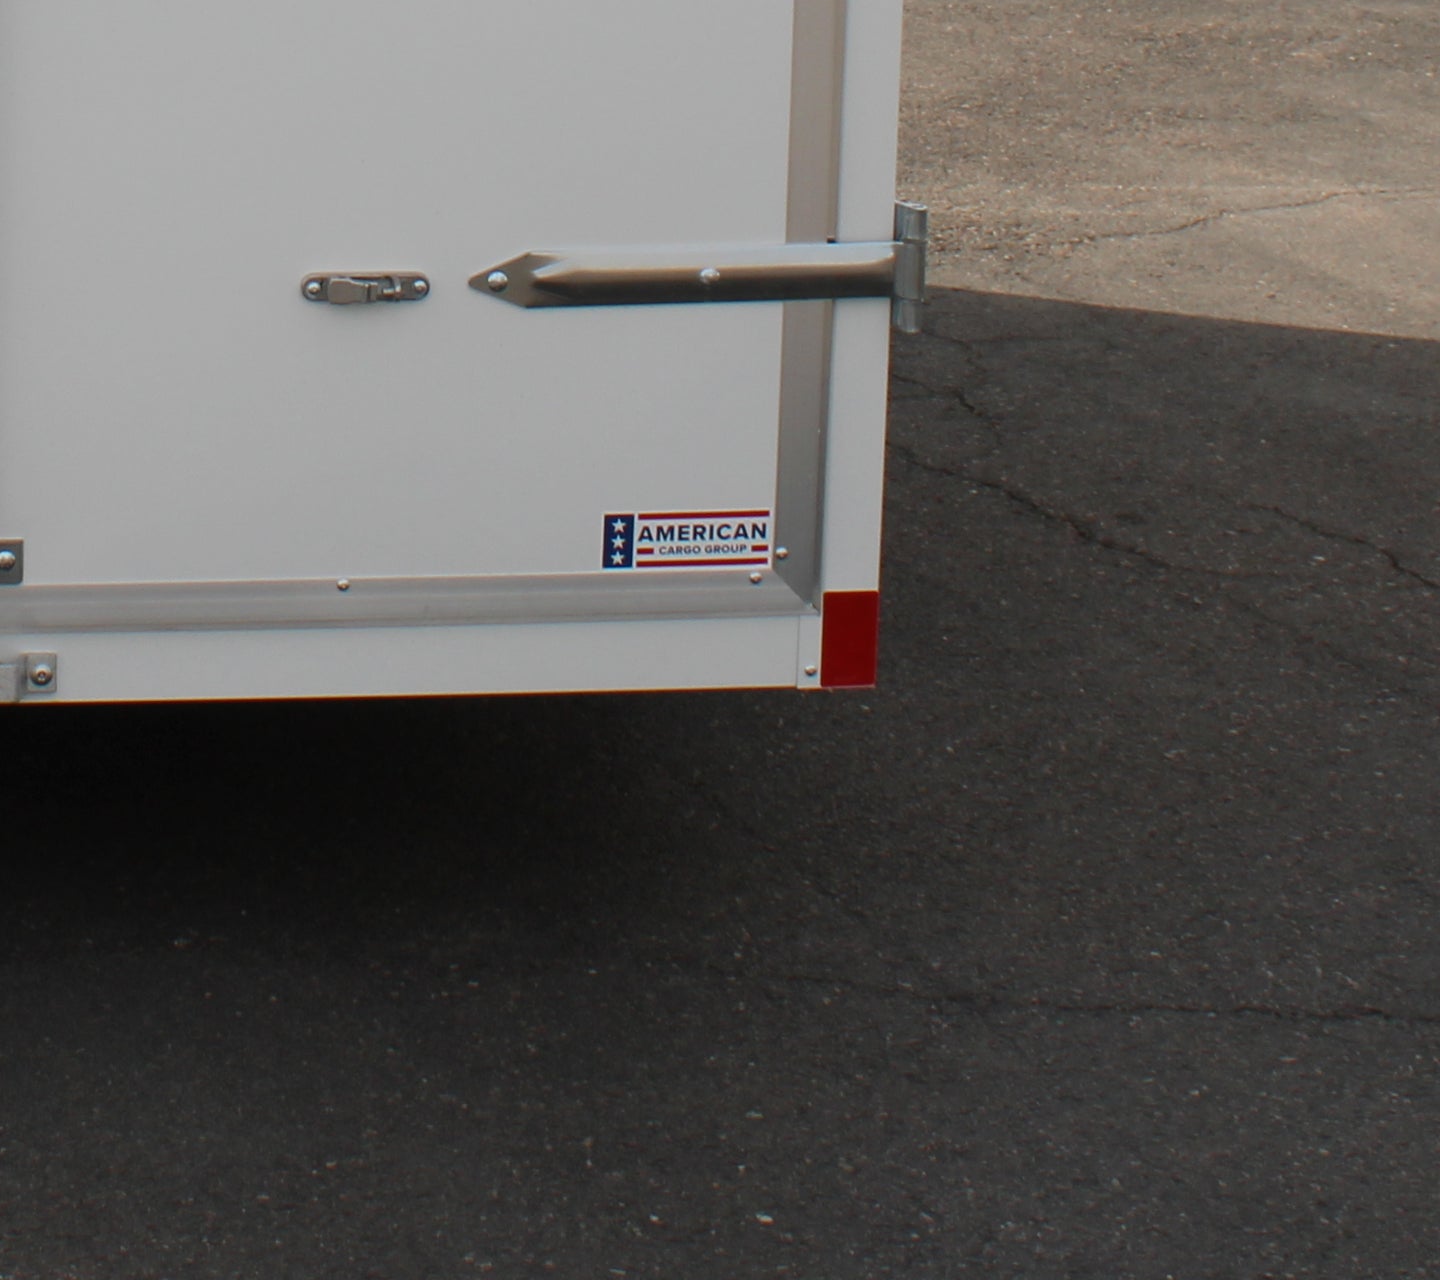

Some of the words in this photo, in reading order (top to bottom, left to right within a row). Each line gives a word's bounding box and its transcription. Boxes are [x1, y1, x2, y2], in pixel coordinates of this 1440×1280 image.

[637, 522, 767, 543] AMERICAN
[658, 545, 701, 556] CARGO
[704, 543, 747, 555] GROUP
